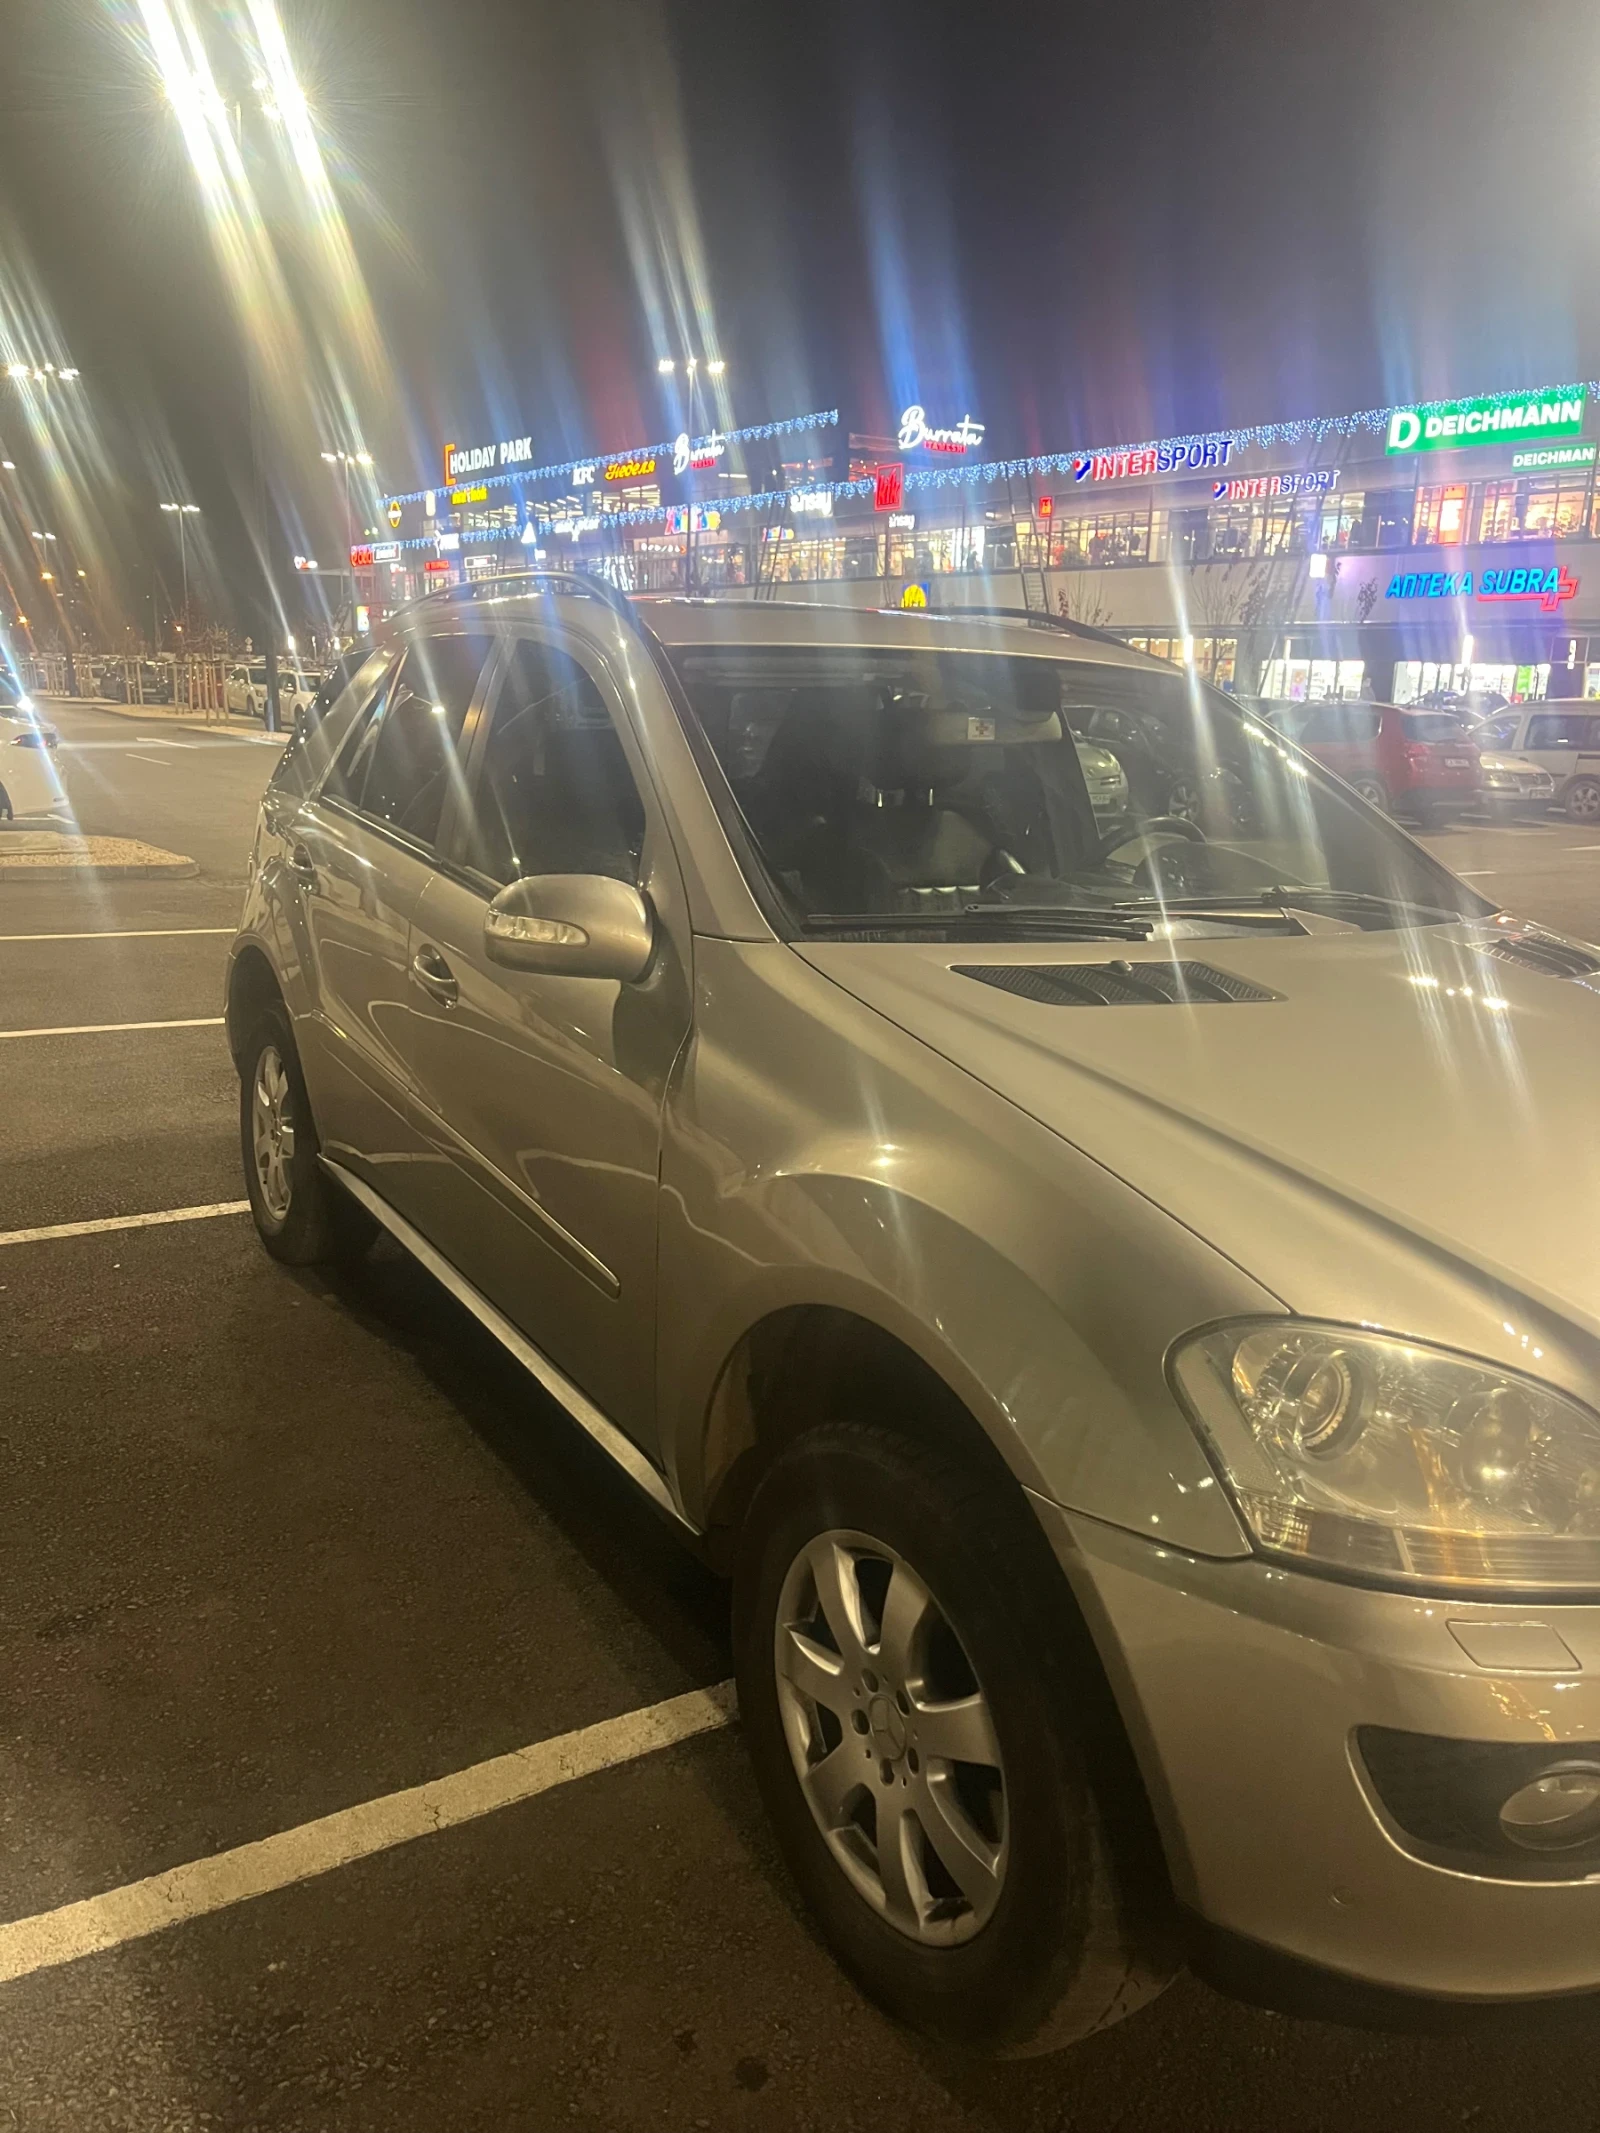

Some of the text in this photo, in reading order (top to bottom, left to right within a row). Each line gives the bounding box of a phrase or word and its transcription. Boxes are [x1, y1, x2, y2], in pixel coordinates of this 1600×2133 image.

[897, 404, 985, 449] Burrata
[1425, 399, 1582, 437] DEICHMANN
[449, 437, 532, 474] HOLIDAY PARK
[673, 428, 725, 475] Burrata
[1092, 439, 1235, 481] INTERSPORT
[1513, 446, 1600, 467] DEICHMAN
[573, 465, 595, 486] KFC
[604, 459, 656, 481] Неделя
[1228, 469, 1341, 501] INTERSPORT
[789, 489, 832, 514] sinsay
[1385, 567, 1559, 599] АПТЕКА SUBRA
